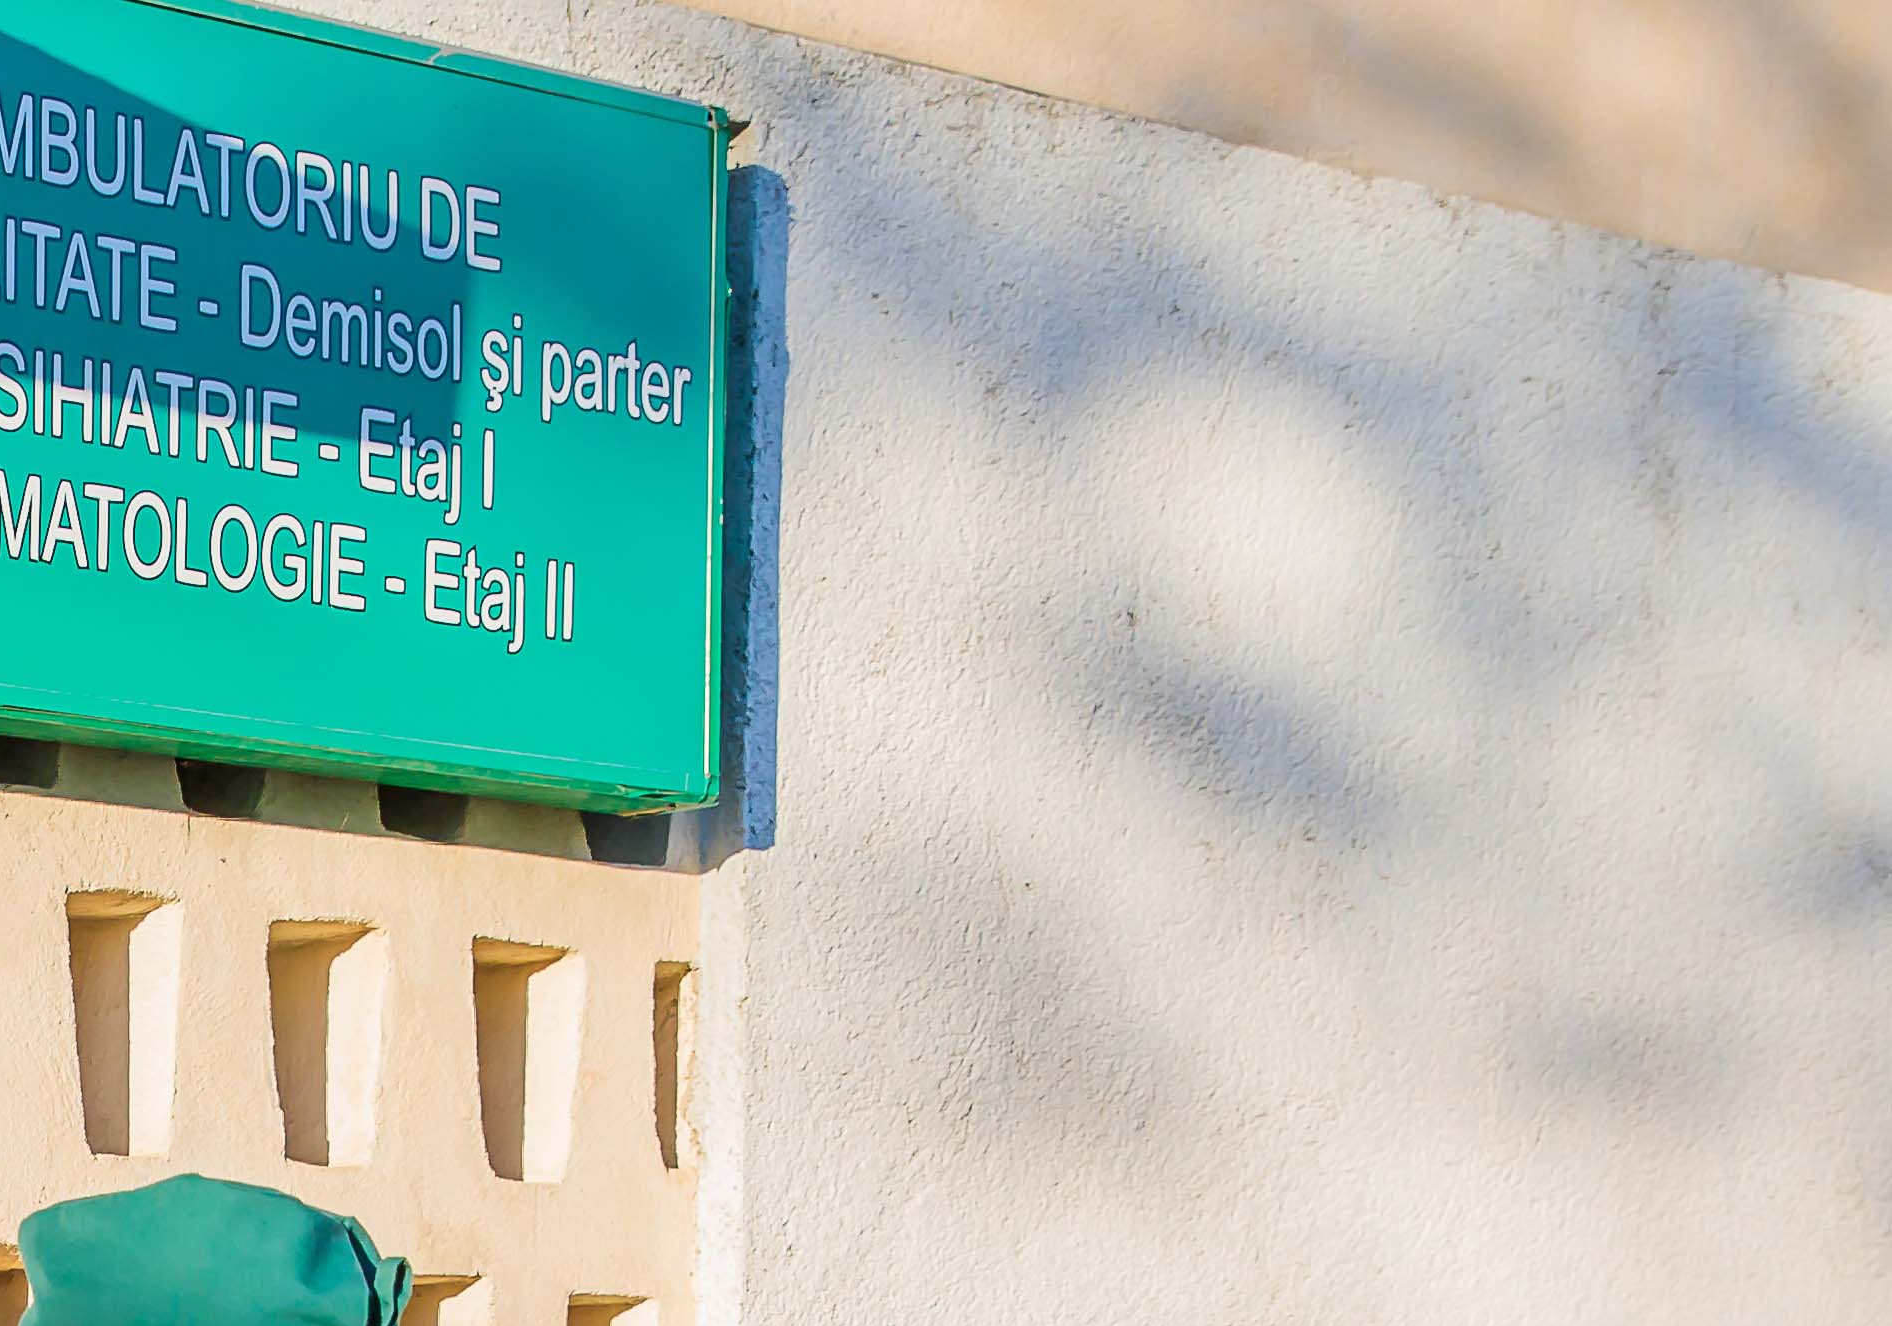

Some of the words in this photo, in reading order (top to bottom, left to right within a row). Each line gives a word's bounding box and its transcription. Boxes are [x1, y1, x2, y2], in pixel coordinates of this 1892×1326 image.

[420, 176, 502, 272] DE
[240, 263, 462, 382] Demisol
[541, 340, 692, 426] parter
[358, 407, 462, 525] Etaj
[482, 428, 495, 510] I
[424, 538, 526, 654] Etaj
[545, 559, 575, 641] II
